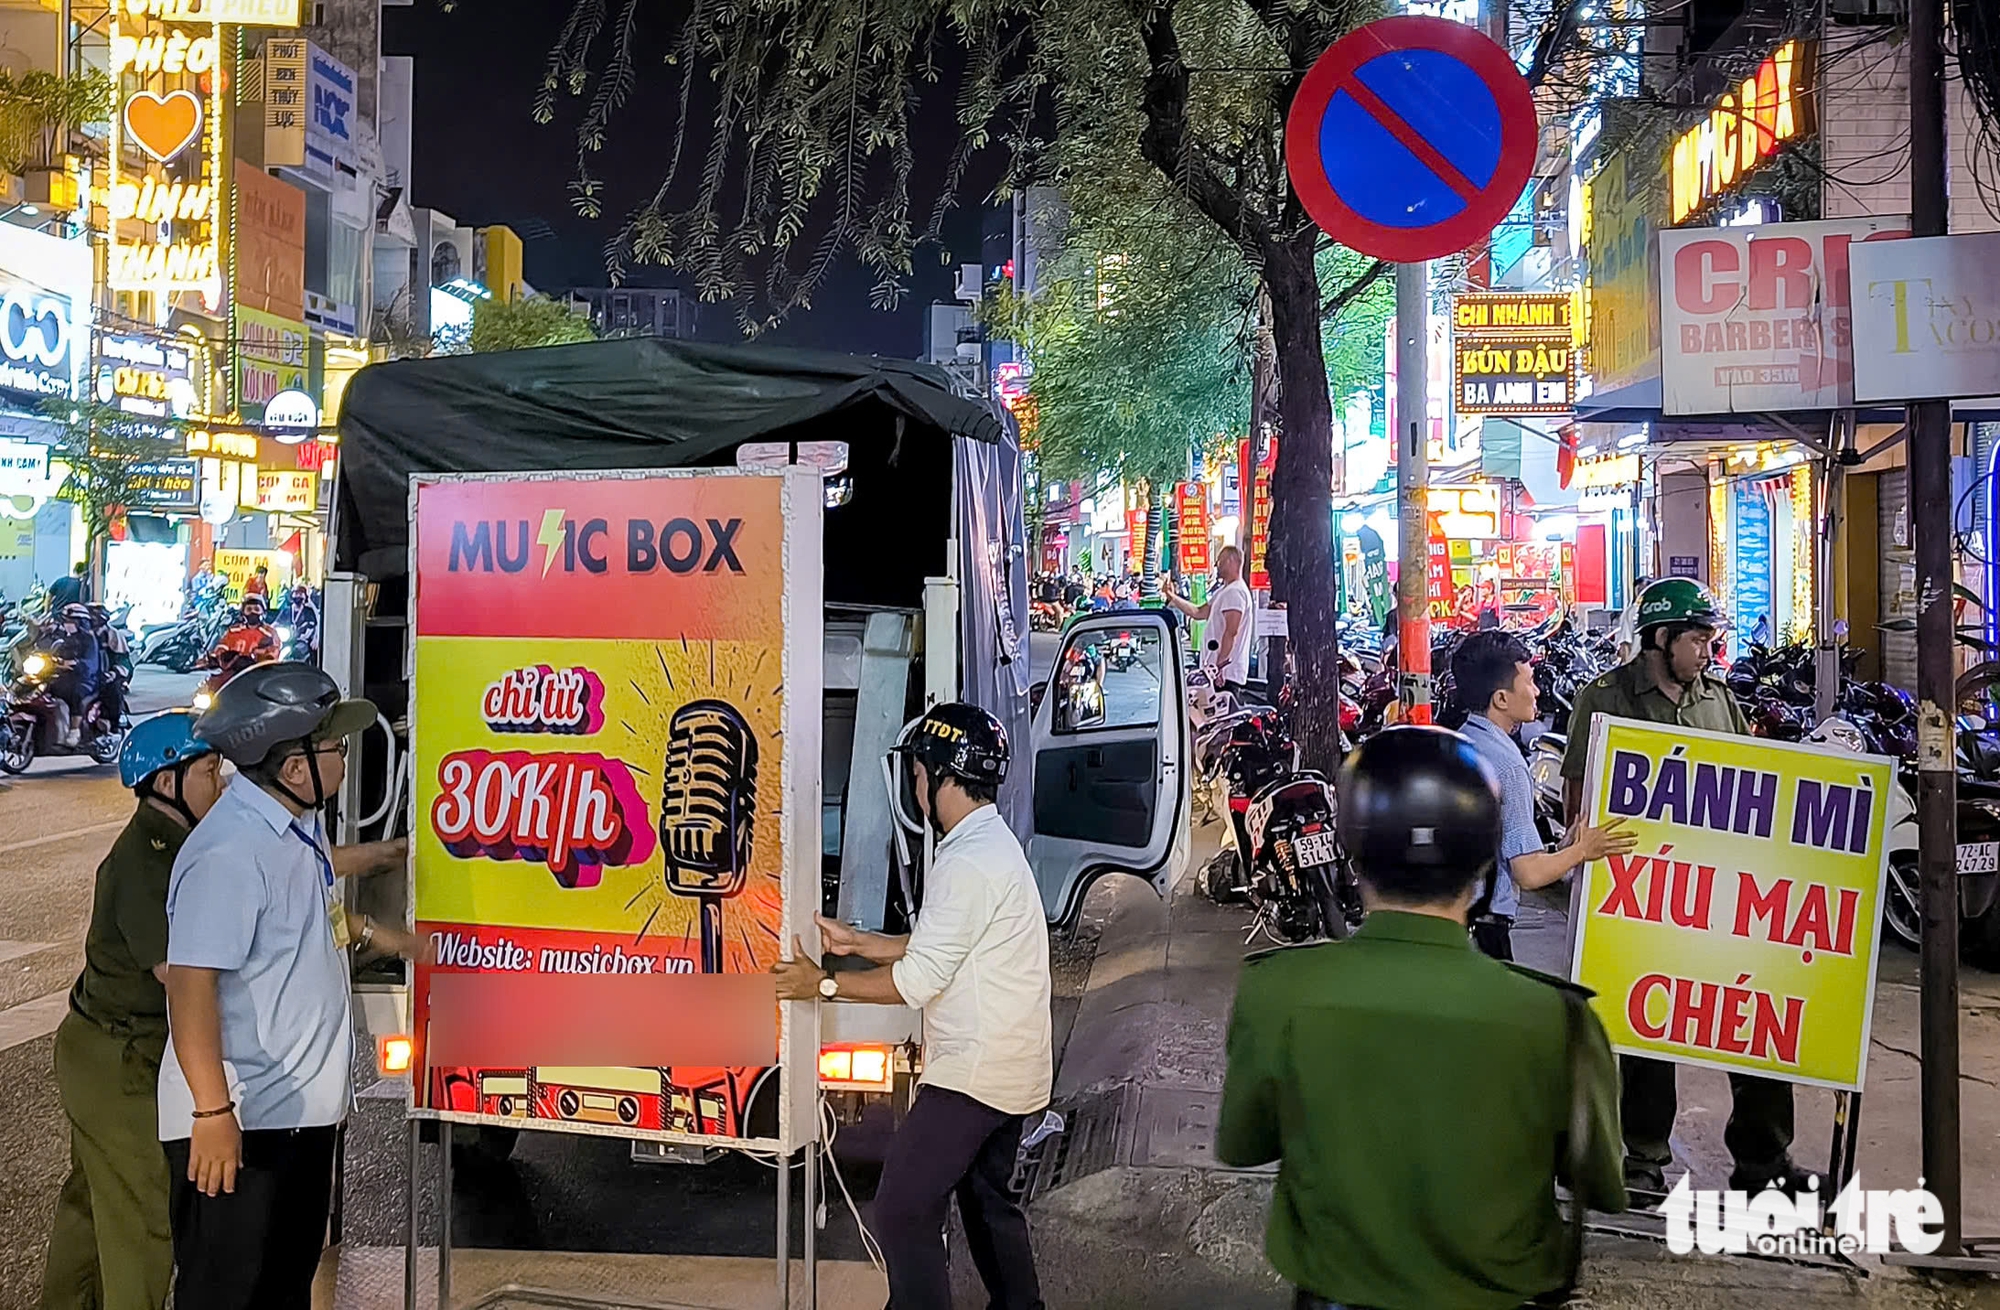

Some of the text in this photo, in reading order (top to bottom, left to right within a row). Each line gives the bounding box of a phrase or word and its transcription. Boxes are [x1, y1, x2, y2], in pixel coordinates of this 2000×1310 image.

[1516, 343, 1567, 379] ĐẬU
[1464, 382, 1490, 405] BA
[627, 518, 745, 573] BOX
[1642, 597, 1672, 615] Grab
[1608, 747, 1872, 854] BÁNH MÌ
[1598, 844, 1859, 963] XÍU MẠI
[430, 932, 533, 970] Website:
[1627, 974, 1804, 1064] CHÉN
